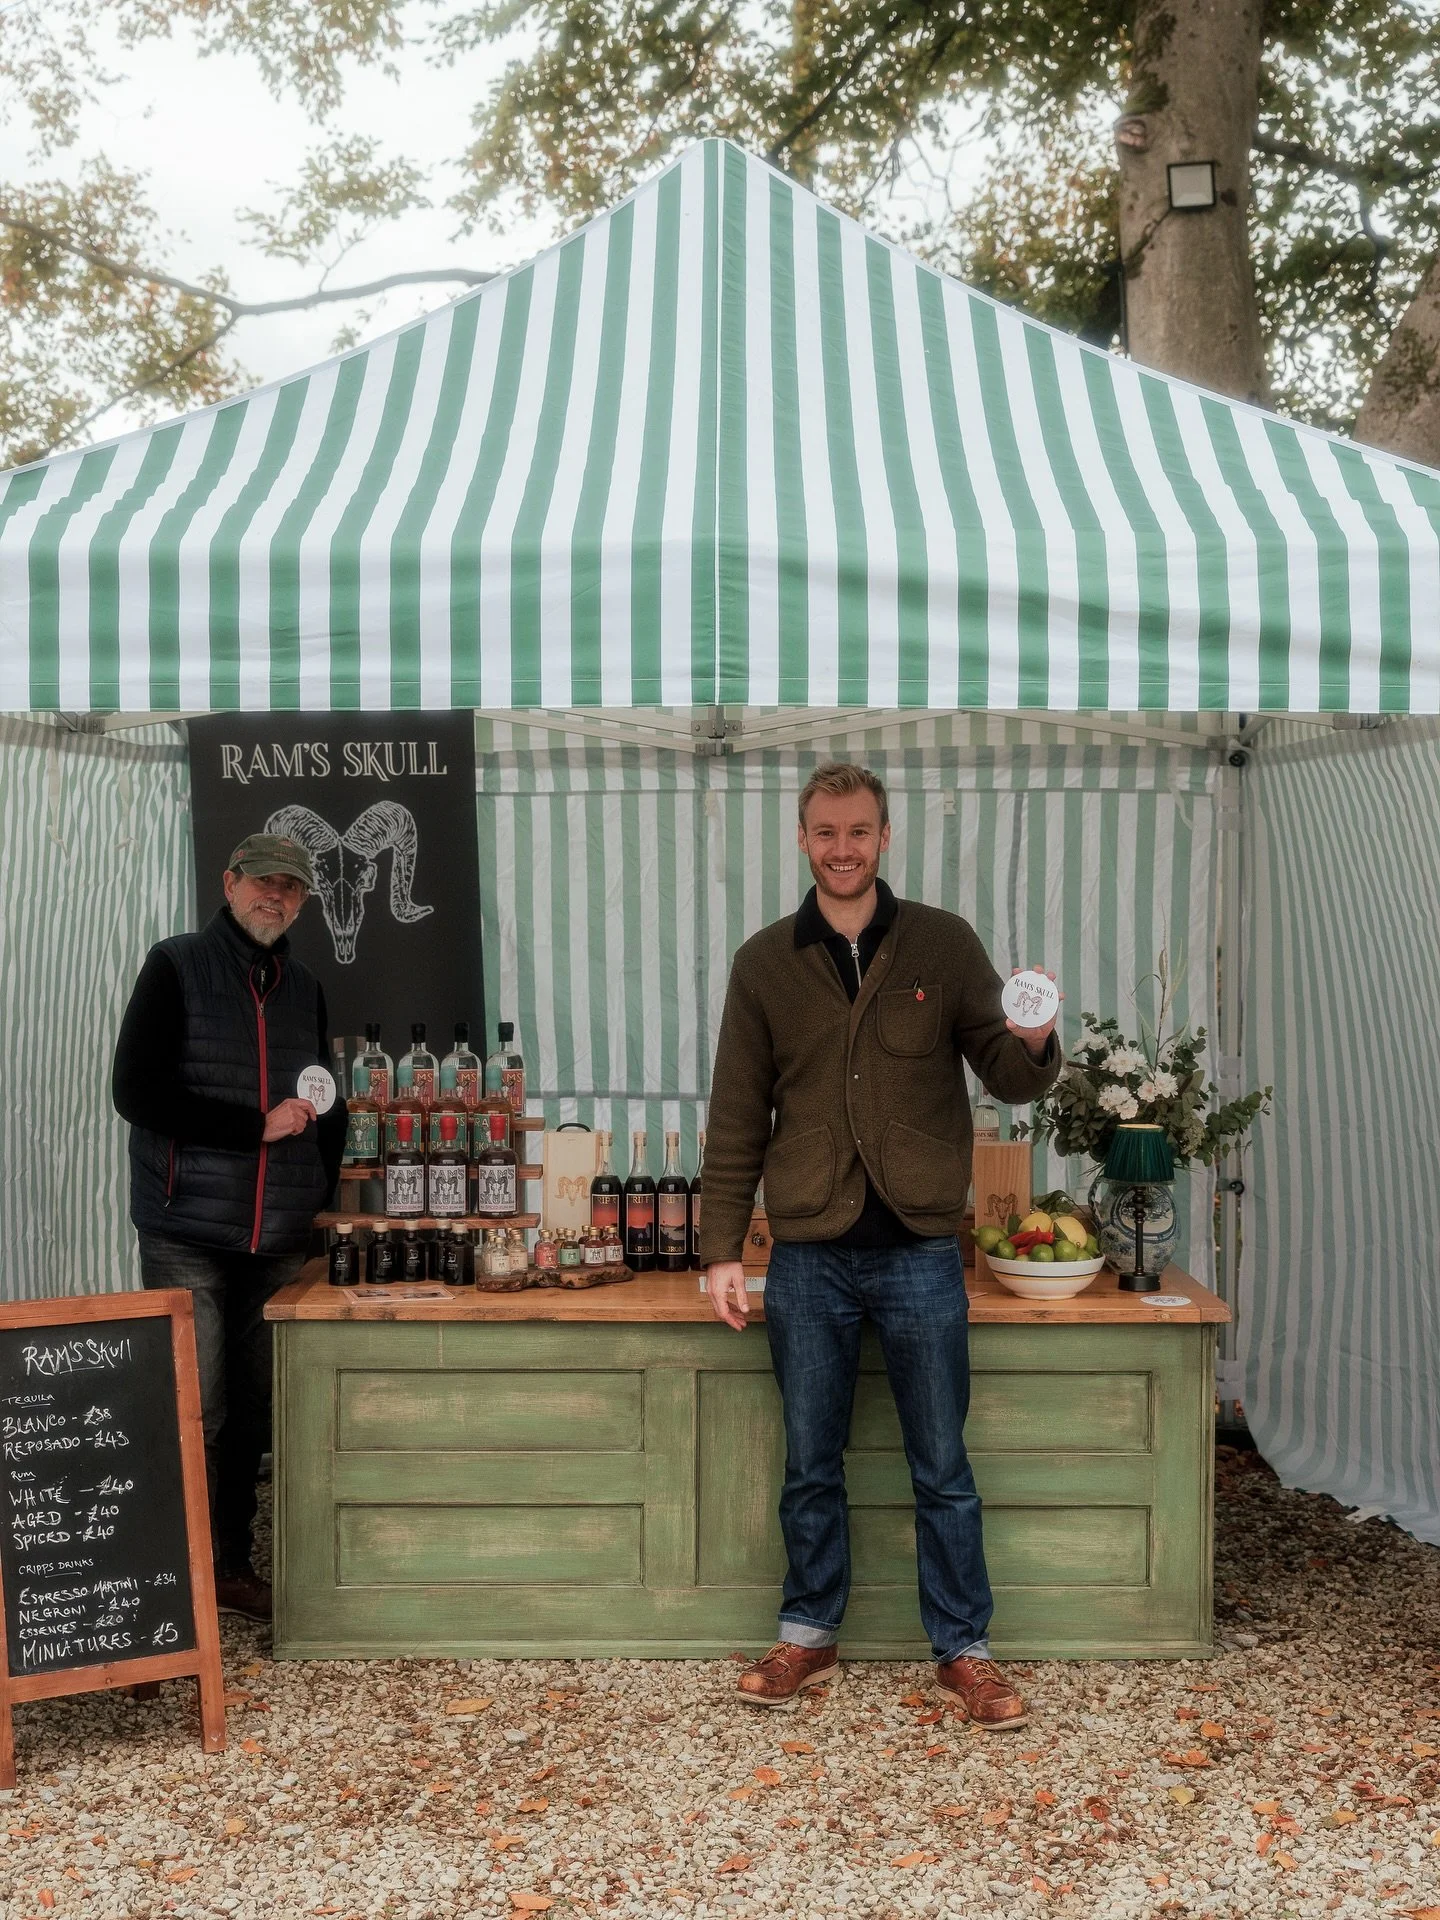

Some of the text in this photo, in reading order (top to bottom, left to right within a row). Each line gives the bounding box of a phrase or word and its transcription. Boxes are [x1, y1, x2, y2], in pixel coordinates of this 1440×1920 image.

[220, 742, 448, 784] RAM'S SKULL
[1035, 987, 1054, 999] SKULL
[388, 1168, 423, 1180] RAM'S
[430, 1168, 465, 1180] RAM'S
[479, 1168, 515, 1180] RAM'S
[3, 1394, 56, 1405] TEQUILA
[3, 1413, 66, 1439] BLANCO
[3, 1437, 81, 1462] REPOSADO
[9, 1486, 71, 1509] WHITE
[96, 1475, 134, 1496] £40
[12, 1511, 61, 1529] AGED
[87, 1504, 120, 1523] £40
[13, 1531, 71, 1551] SPICED
[18, 1559, 94, 1575] CRIPPS DRINKS
[19, 1587, 89, 1605] ESPRESSO
[93, 1577, 139, 1599] MARTINI
[153, 1573, 177, 1587] £34
[19, 1604, 86, 1625] NEGRONI
[108, 1598, 140, 1612] £40
[19, 1621, 77, 1639] ESSENCES
[95, 1614, 124, 1628] £20
[22, 1632, 132, 1668] MINIATURES
[152, 1622, 178, 1646] £5
